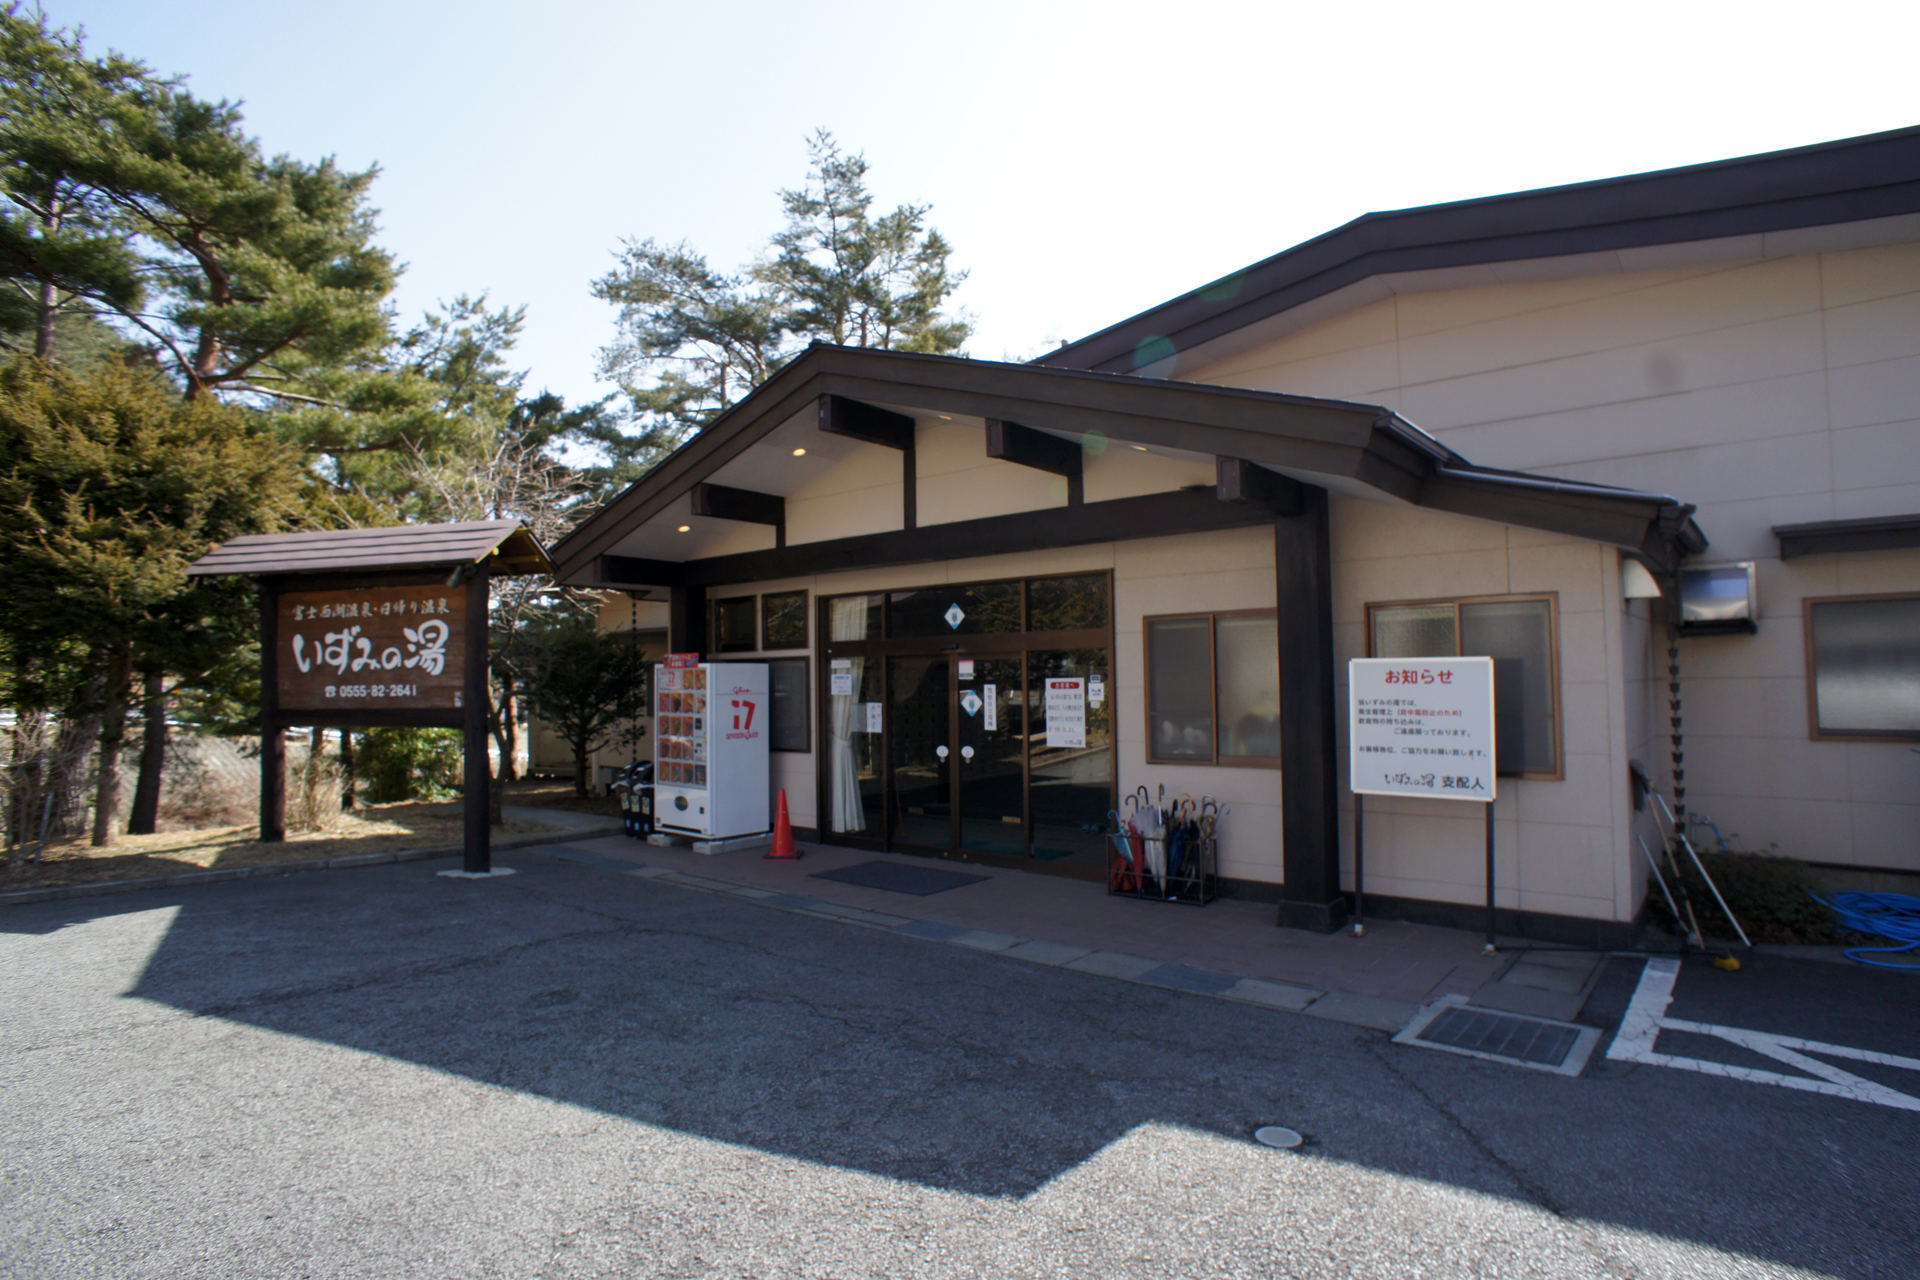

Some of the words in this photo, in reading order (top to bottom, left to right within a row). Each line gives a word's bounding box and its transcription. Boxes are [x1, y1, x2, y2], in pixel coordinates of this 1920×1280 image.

[292, 619, 449, 675] いずみの湯
[1385, 669, 1453, 684] お知らせ
[339, 684, 417, 697] 0555-82-2641
[1385, 773, 1435, 788] いずみの湯
[1442, 775, 1485, 790] 支配人
